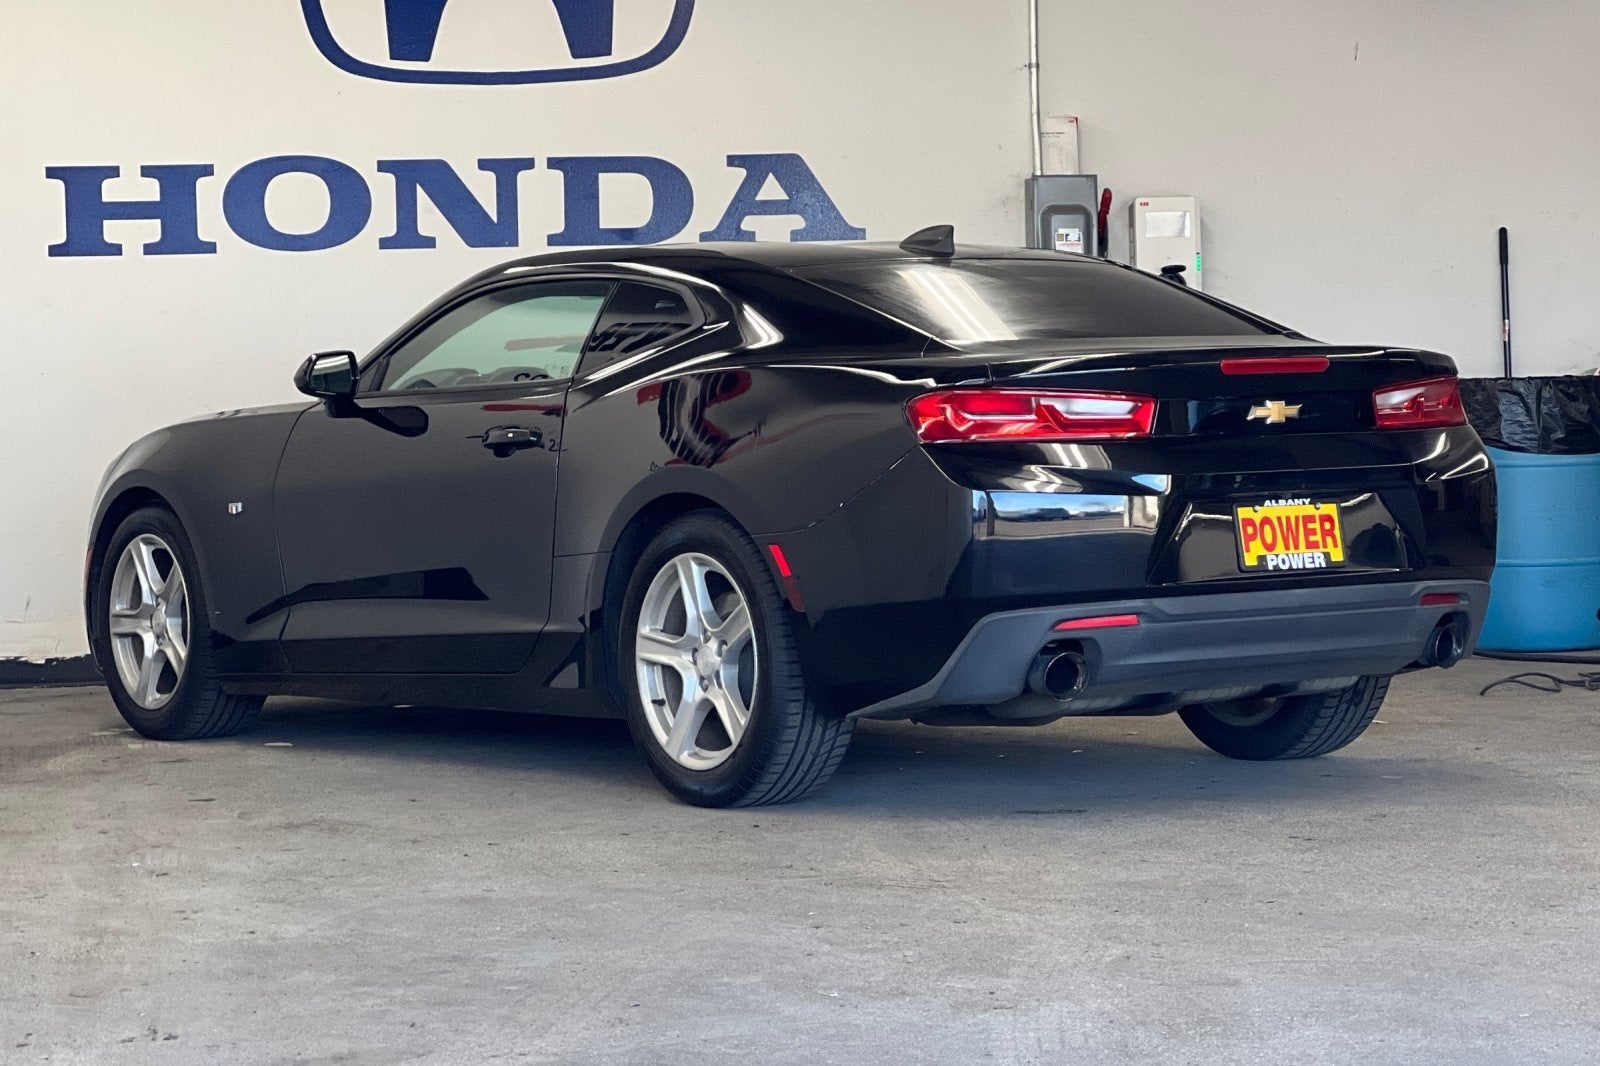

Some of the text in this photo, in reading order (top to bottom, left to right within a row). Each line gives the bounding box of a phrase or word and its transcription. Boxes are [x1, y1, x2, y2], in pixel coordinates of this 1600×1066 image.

[46, 153, 866, 257] HONDA
[1264, 498, 1311, 506] ALBANY
[1240, 514, 1338, 553] POWER
[1266, 552, 1326, 570] POWER
